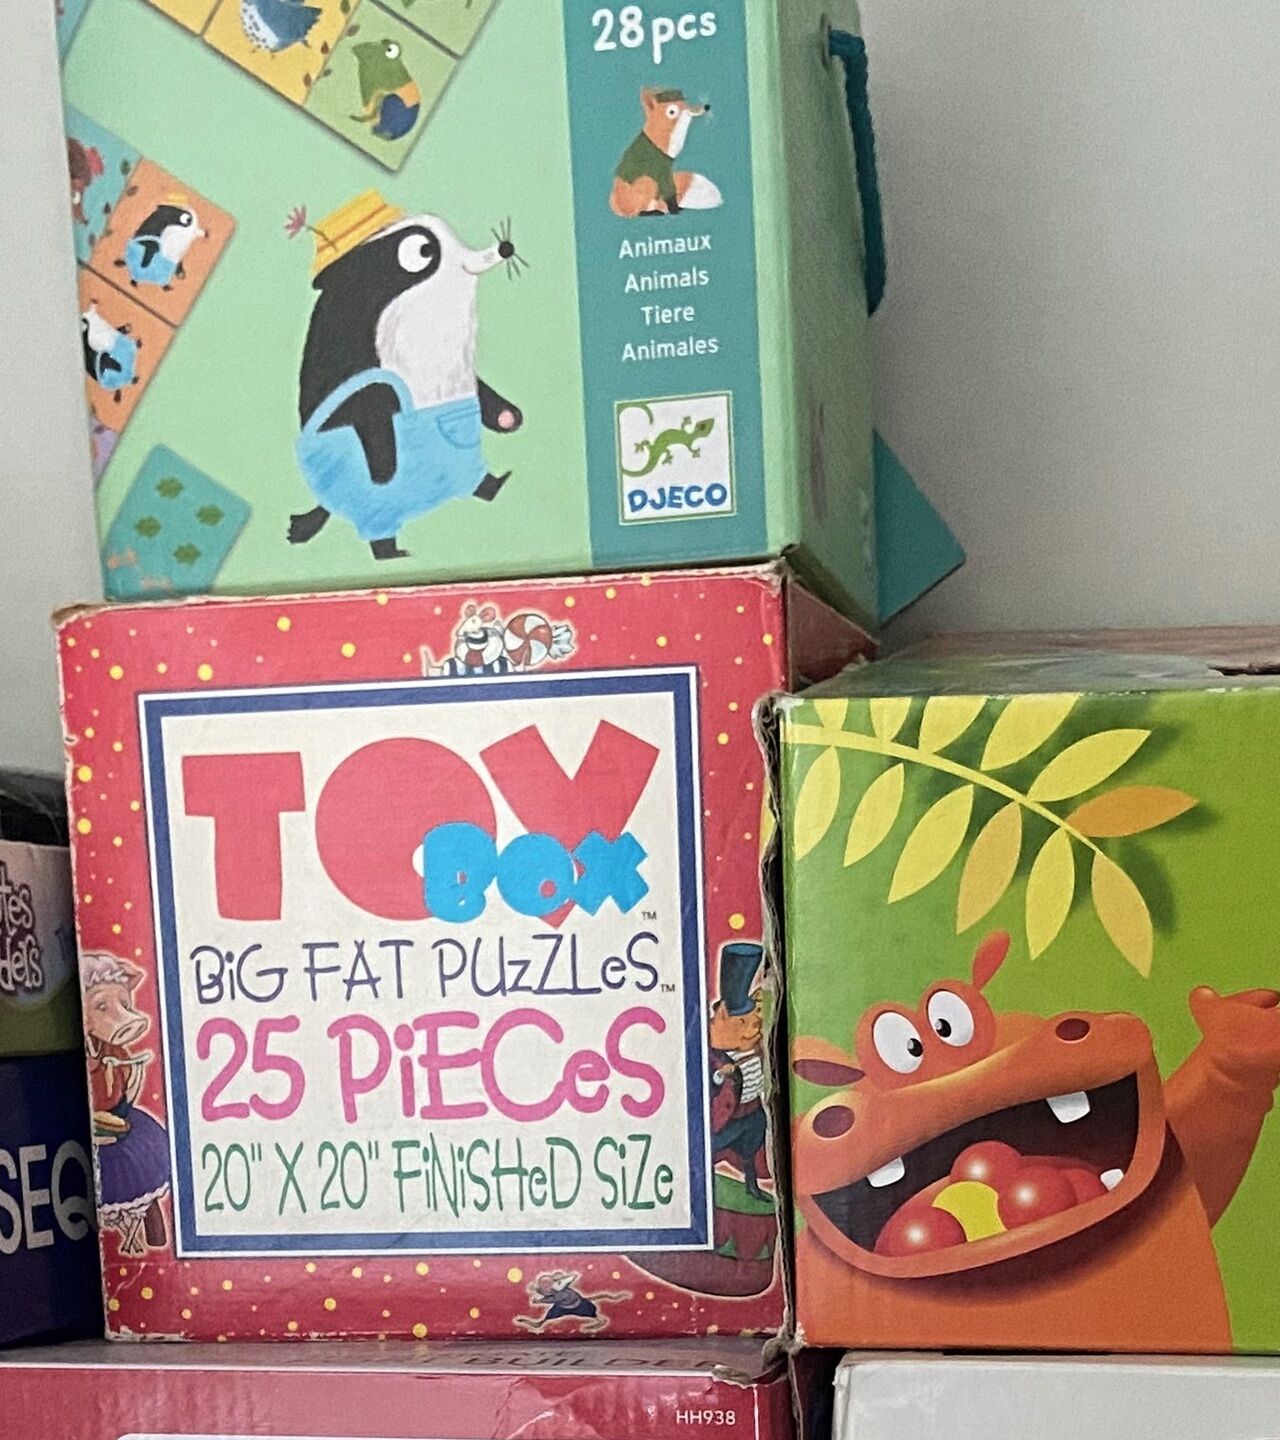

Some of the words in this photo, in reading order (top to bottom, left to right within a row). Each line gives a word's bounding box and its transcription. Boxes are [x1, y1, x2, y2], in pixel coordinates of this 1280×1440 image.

[618, 234, 712, 259] Animaux
[624, 266, 710, 293] Animals
[640, 305, 696, 326] Tiere
[622, 336, 720, 361] Animales
[626, 482, 729, 513] DJECO
[181, 719, 661, 928] TOY
[418, 821, 650, 924] BOX
[302, 939, 415, 1003] FAT
[195, 1015, 305, 1122] 25
[201, 1141, 263, 1213] 20"
[278, 1141, 307, 1212] X
[319, 1138, 382, 1212] 20"
[675, 1410, 736, 1426] HH938
